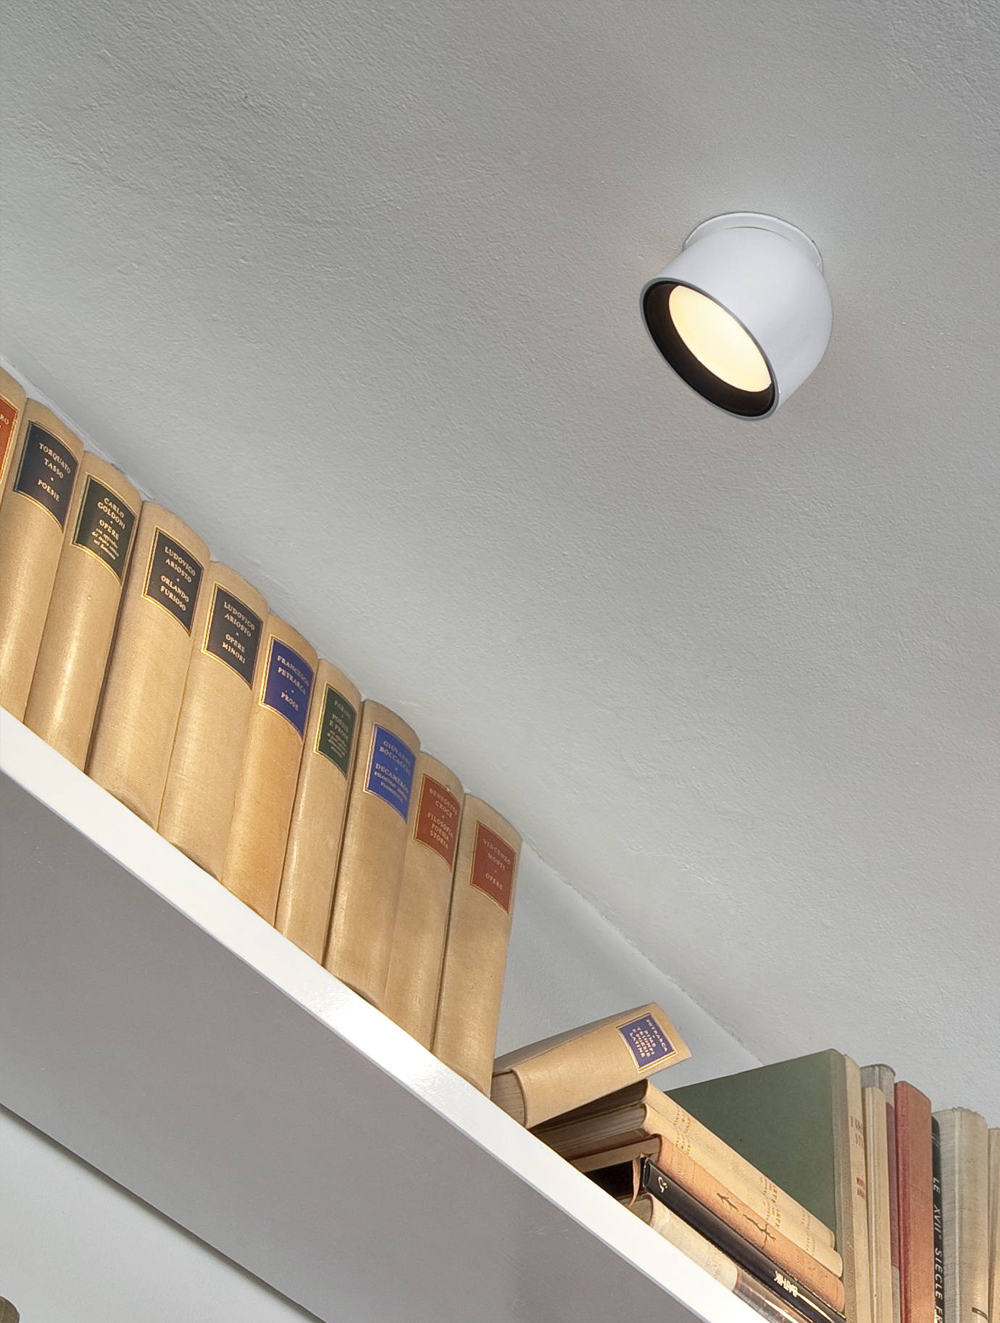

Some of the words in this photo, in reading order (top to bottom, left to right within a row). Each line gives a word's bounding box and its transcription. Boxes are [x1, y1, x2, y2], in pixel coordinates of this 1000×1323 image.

[38, 442, 71, 475] TORQUATO
[43, 458, 64, 479] TASSO
[37, 479, 60, 502] POESIE
[97, 501, 126, 530] GOLDONI
[103, 497, 125, 518] CARLO
[99, 519, 120, 540] OPERE
[164, 546, 196, 577] LUDOVICO
[165, 558, 192, 583] ARIOSTO
[160, 575, 190, 603] ORLANDO
[160, 585, 187, 611] FURIOSO
[223, 601, 255, 631] LUDOVICO
[224, 613, 252, 637] ARIOSTO
[222, 642, 246, 664] MINORI
[225, 634, 246, 653] OPERE
[277, 655, 310, 687] FRANCESCO
[278, 667, 306, 695] PETRARCA
[281, 692, 300, 712] PROSE
[383, 740, 411, 768] GIOVANNI
[429, 788, 458, 816] BENEDETTO
[435, 800, 453, 819] CROCE
[429, 830, 449, 849] STORIA
[485, 872, 504, 891] OPERE
[645, 1019, 668, 1052] PETRARCA
[933, 1177, 941, 1194] LE
